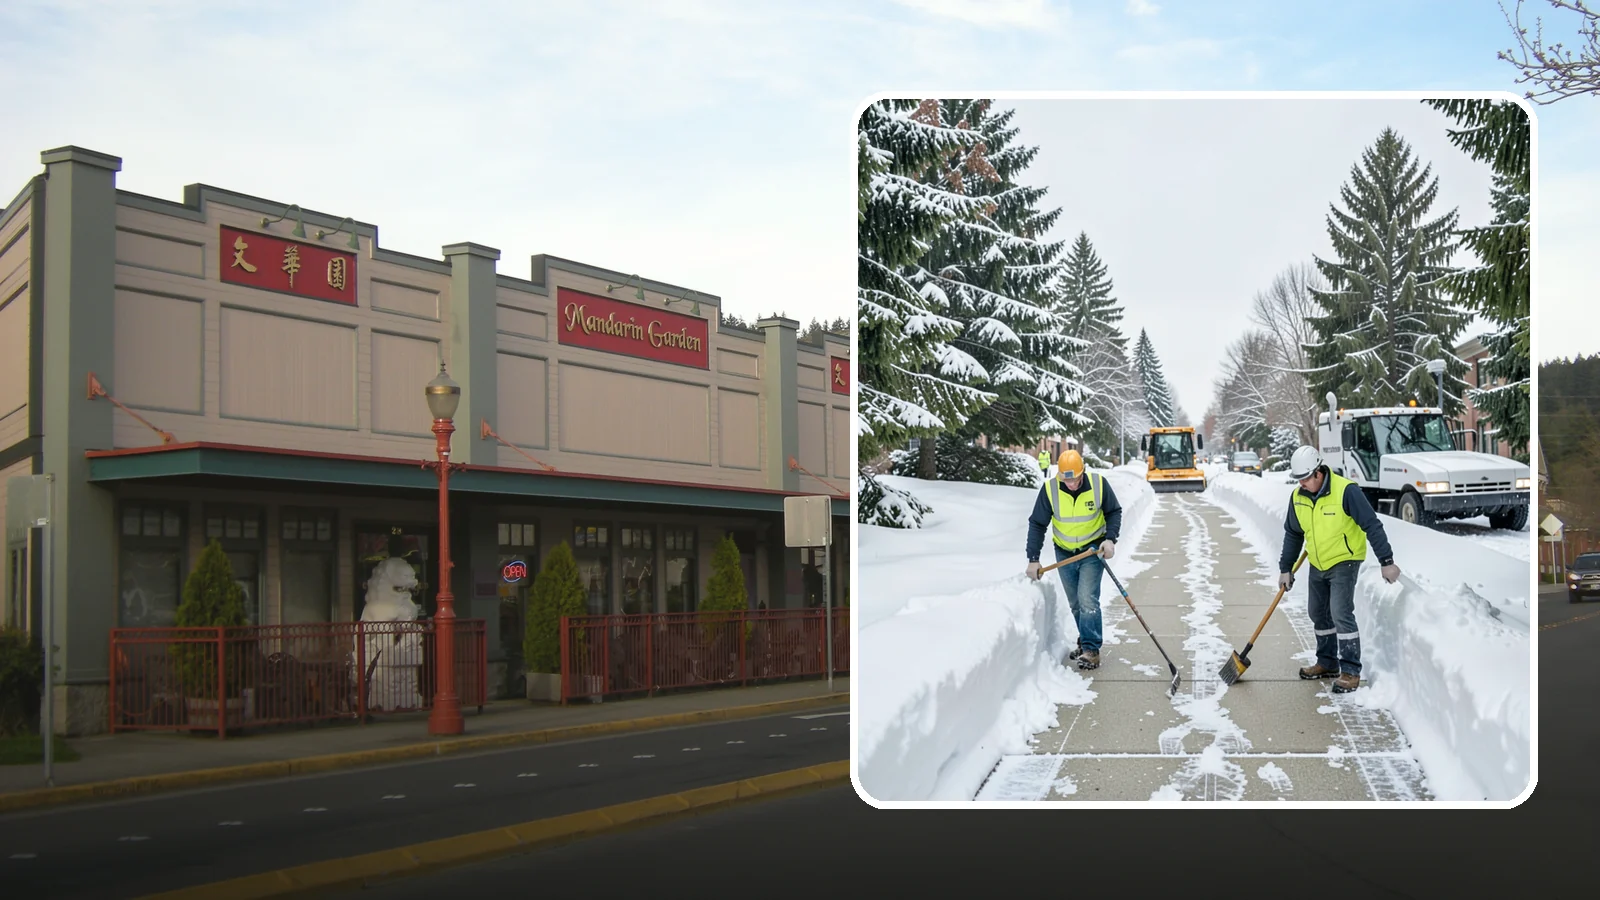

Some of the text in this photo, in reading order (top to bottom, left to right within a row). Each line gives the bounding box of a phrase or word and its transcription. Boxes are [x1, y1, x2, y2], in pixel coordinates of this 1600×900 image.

[231, 235, 346, 291] 文華園
[564, 302, 701, 352] Mandarin Garden
[503, 565, 527, 578] OPEN
